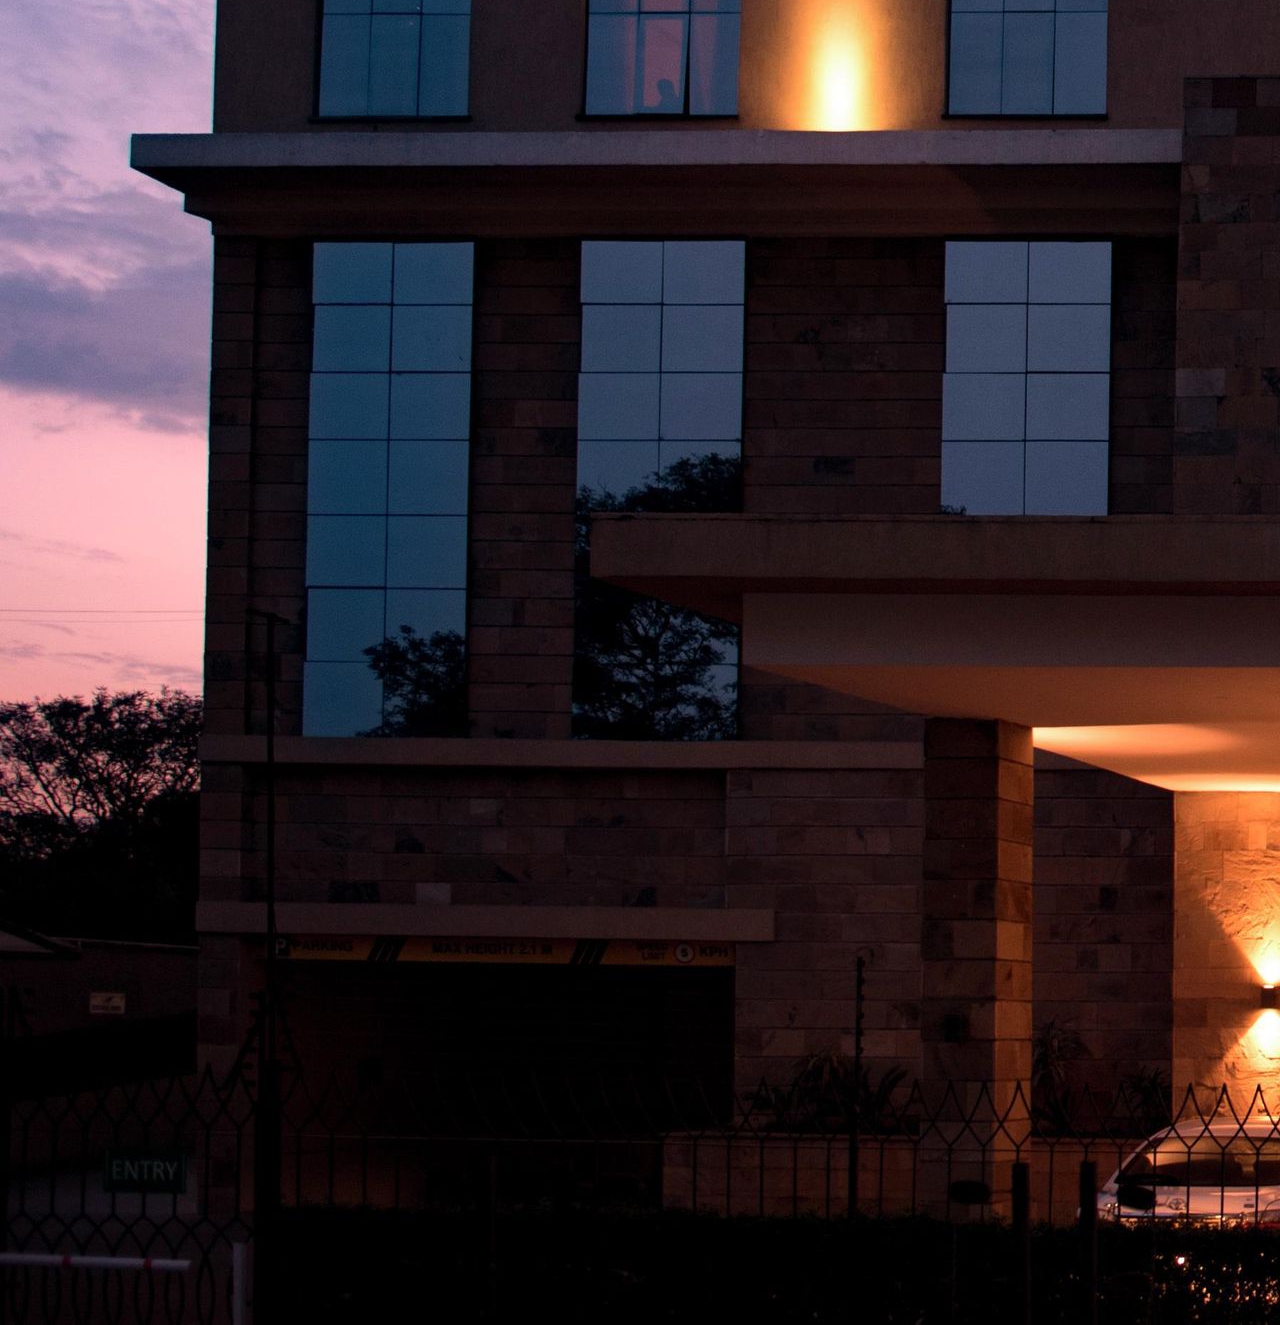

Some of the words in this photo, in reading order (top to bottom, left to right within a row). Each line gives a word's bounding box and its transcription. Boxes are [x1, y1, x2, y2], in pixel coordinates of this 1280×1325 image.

[432, 941, 461, 953] MAX
[465, 942, 513, 954] HEIGHT
[111, 1159, 178, 1180] ENTRY
